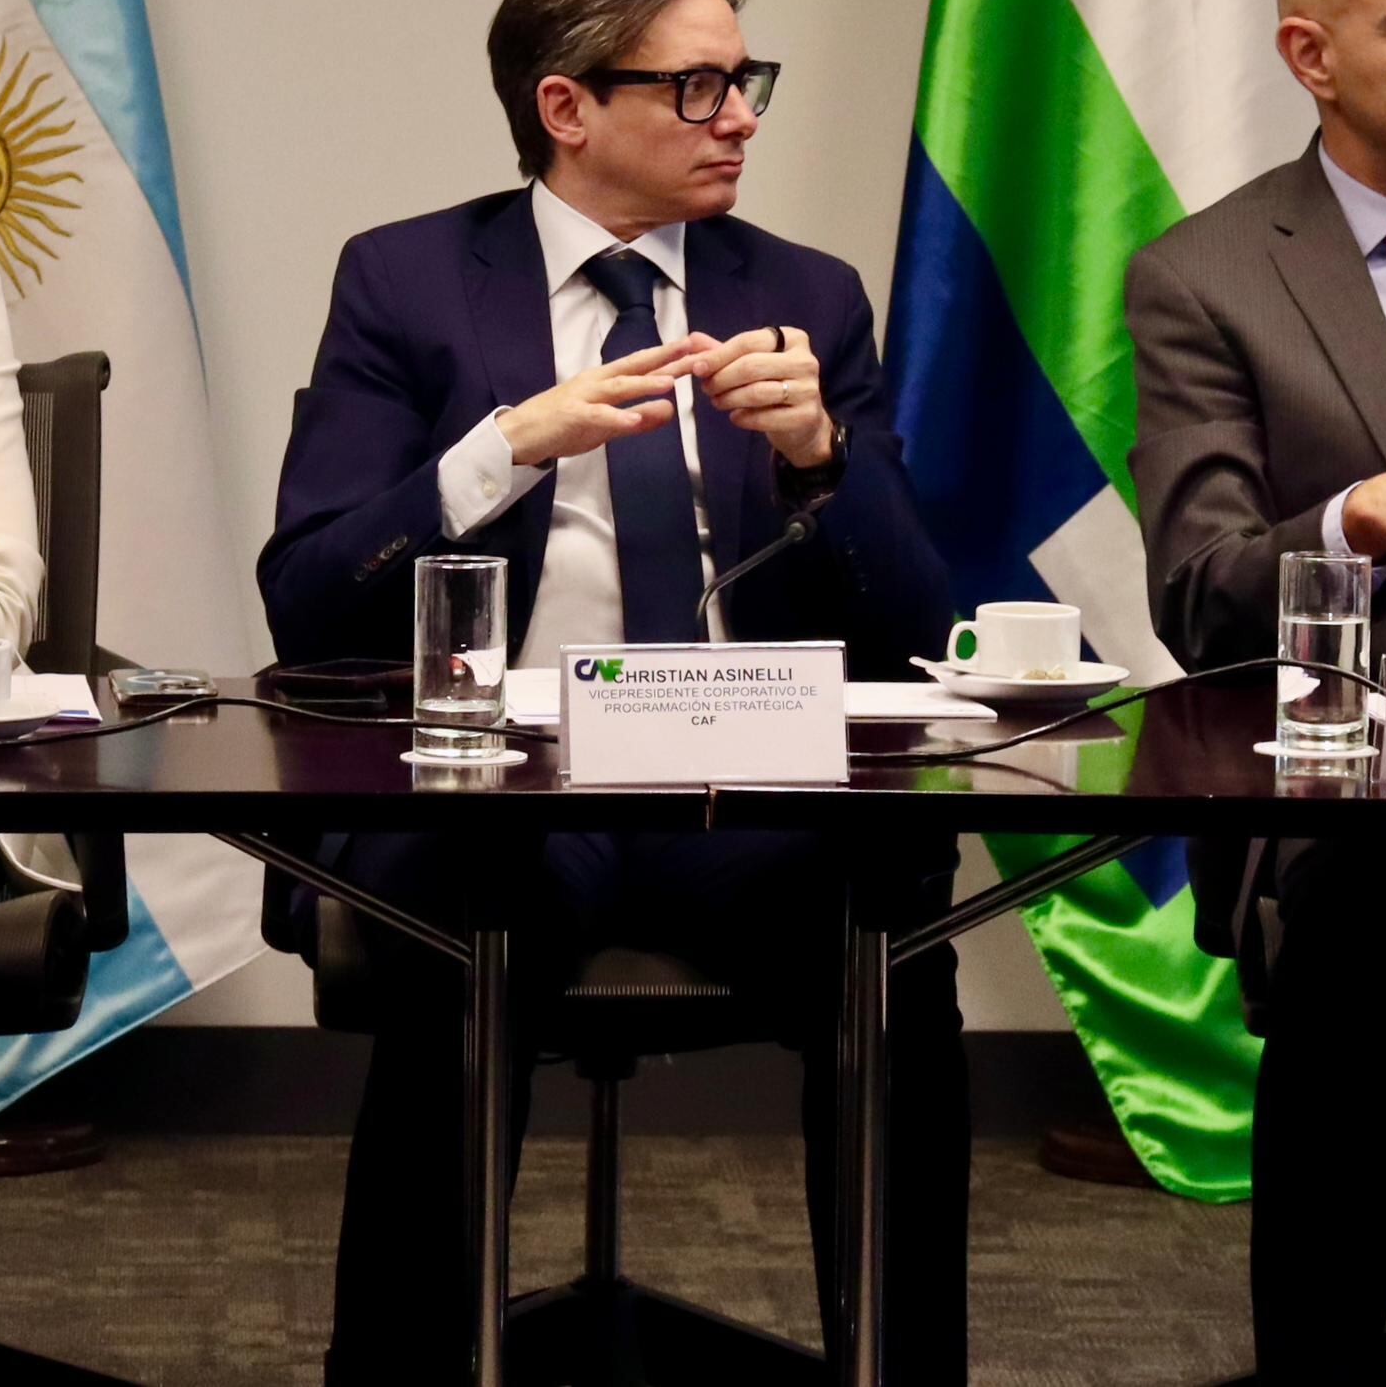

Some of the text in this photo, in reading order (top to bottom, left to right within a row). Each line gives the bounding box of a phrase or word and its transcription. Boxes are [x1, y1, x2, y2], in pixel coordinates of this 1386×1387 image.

[575, 658, 624, 683] CAF
[614, 668, 792, 684] CHRISTIAN ASINELLI
[589, 686, 817, 700] VICEPRESIDENTE CORPORATIVO DE
[605, 699, 803, 713] PROGRAMACIÓN ESTRATÉGICA
[691, 716, 716, 726] CAF
